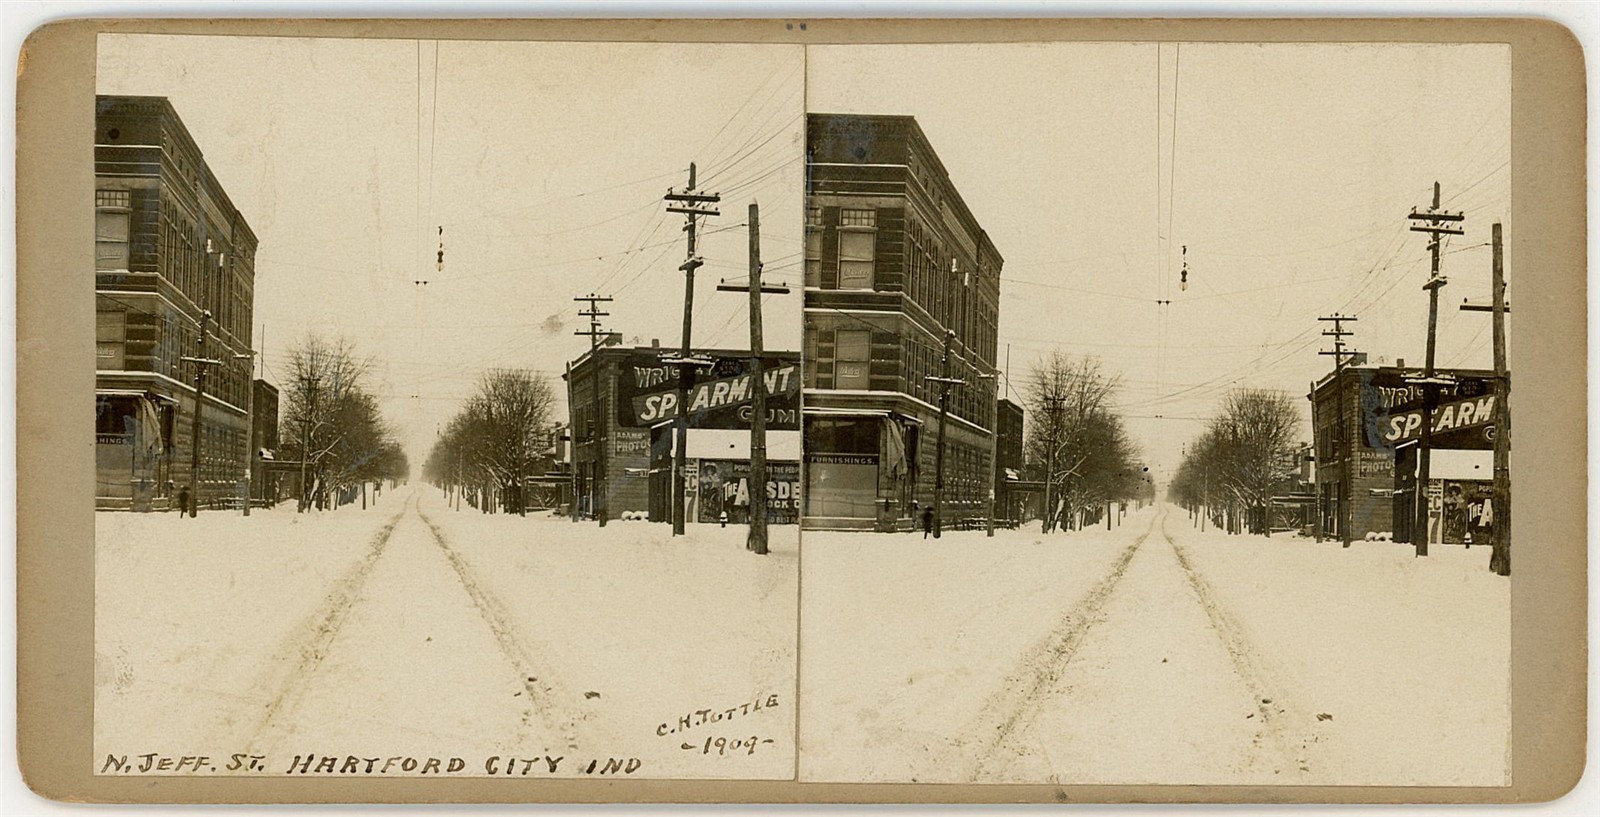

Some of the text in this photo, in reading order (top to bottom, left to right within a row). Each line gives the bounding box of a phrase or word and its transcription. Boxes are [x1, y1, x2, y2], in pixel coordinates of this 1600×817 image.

[639, 365, 795, 421] SPARMNT
[1385, 396, 1496, 441] SPARM
[810, 456, 875, 465] FURNISHINGS.
[722, 477, 800, 506] THE ASDE
[766, 500, 789, 508] OCK
[686, 491, 697, 523] 7
[1467, 502, 1482, 522] THE
[1430, 511, 1441, 544] 7
[137, 752, 217, 773] JEFF.
[226, 753, 265, 772] ST.
[286, 754, 466, 774] HARTFORD
[485, 756, 564, 775] CITY
[586, 757, 642, 775] IND
